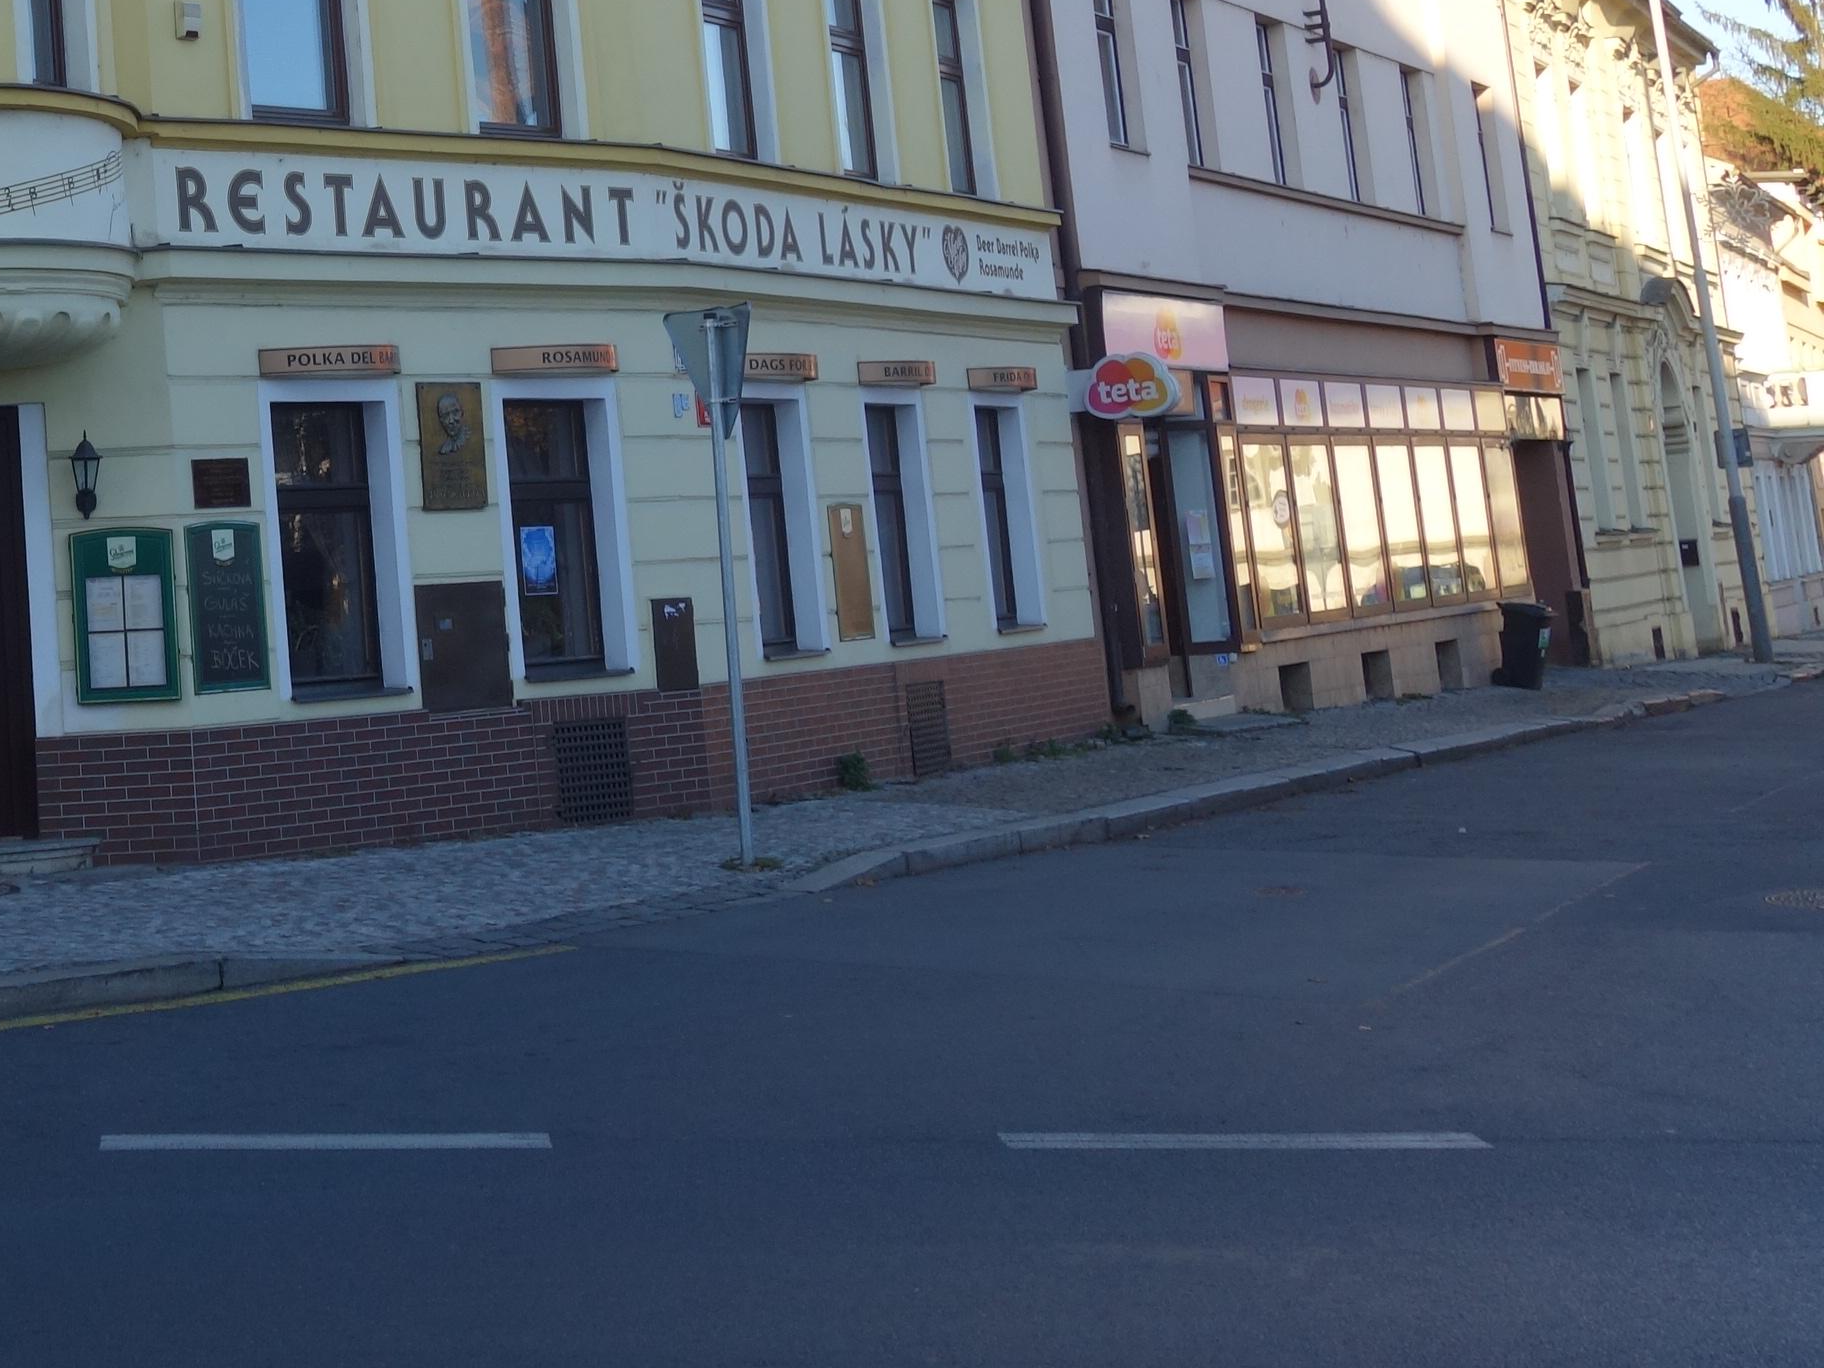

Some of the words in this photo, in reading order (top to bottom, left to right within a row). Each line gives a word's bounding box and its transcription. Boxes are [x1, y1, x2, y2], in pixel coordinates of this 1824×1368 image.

[175, 166, 634, 246] RESTAURANT
[656, 180, 803, 262] "ŠKODA
[818, 205, 931, 274] LÁSKY"
[1019, 240, 1040, 264] Polka
[979, 258, 1024, 281] Rosamunde
[1157, 327, 1180, 348] teta
[287, 352, 346, 368] POLKA
[351, 351, 376, 365] DEL
[749, 358, 785, 370] DAGS
[884, 366, 922, 377] BARRIL
[993, 372, 1022, 383] FRIDA
[1098, 378, 1159, 404] teta
